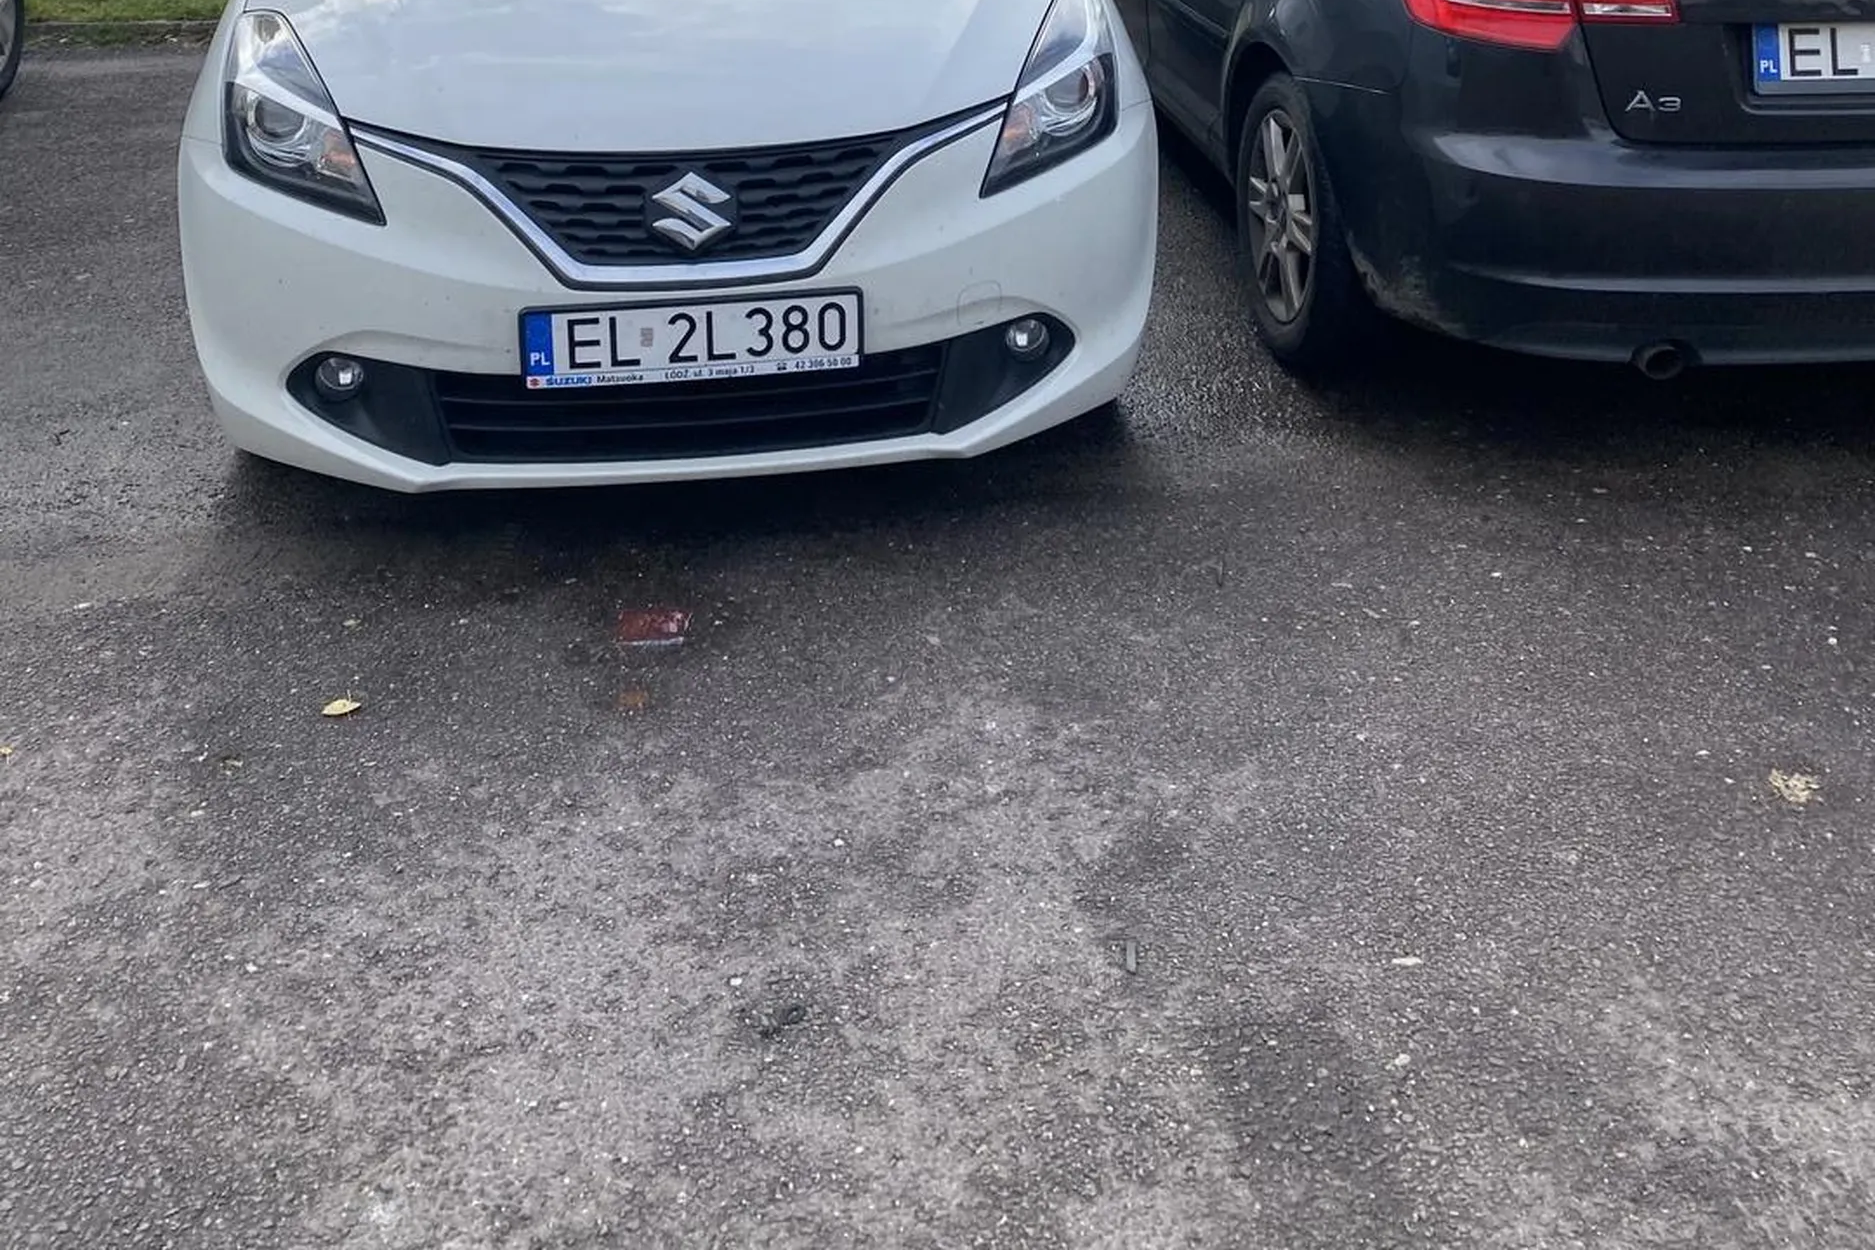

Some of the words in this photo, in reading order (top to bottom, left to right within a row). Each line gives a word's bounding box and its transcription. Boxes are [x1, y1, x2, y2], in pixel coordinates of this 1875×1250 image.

[1788, 27, 1858, 77] EL
[1760, 59, 1777, 73] PL
[1625, 90, 1682, 112] A3
[566, 316, 641, 370] EL
[667, 301, 847, 364] 2L380
[530, 352, 550, 366] PL
[795, 360, 806, 369] 42
[545, 375, 593, 387] SUZUKI
